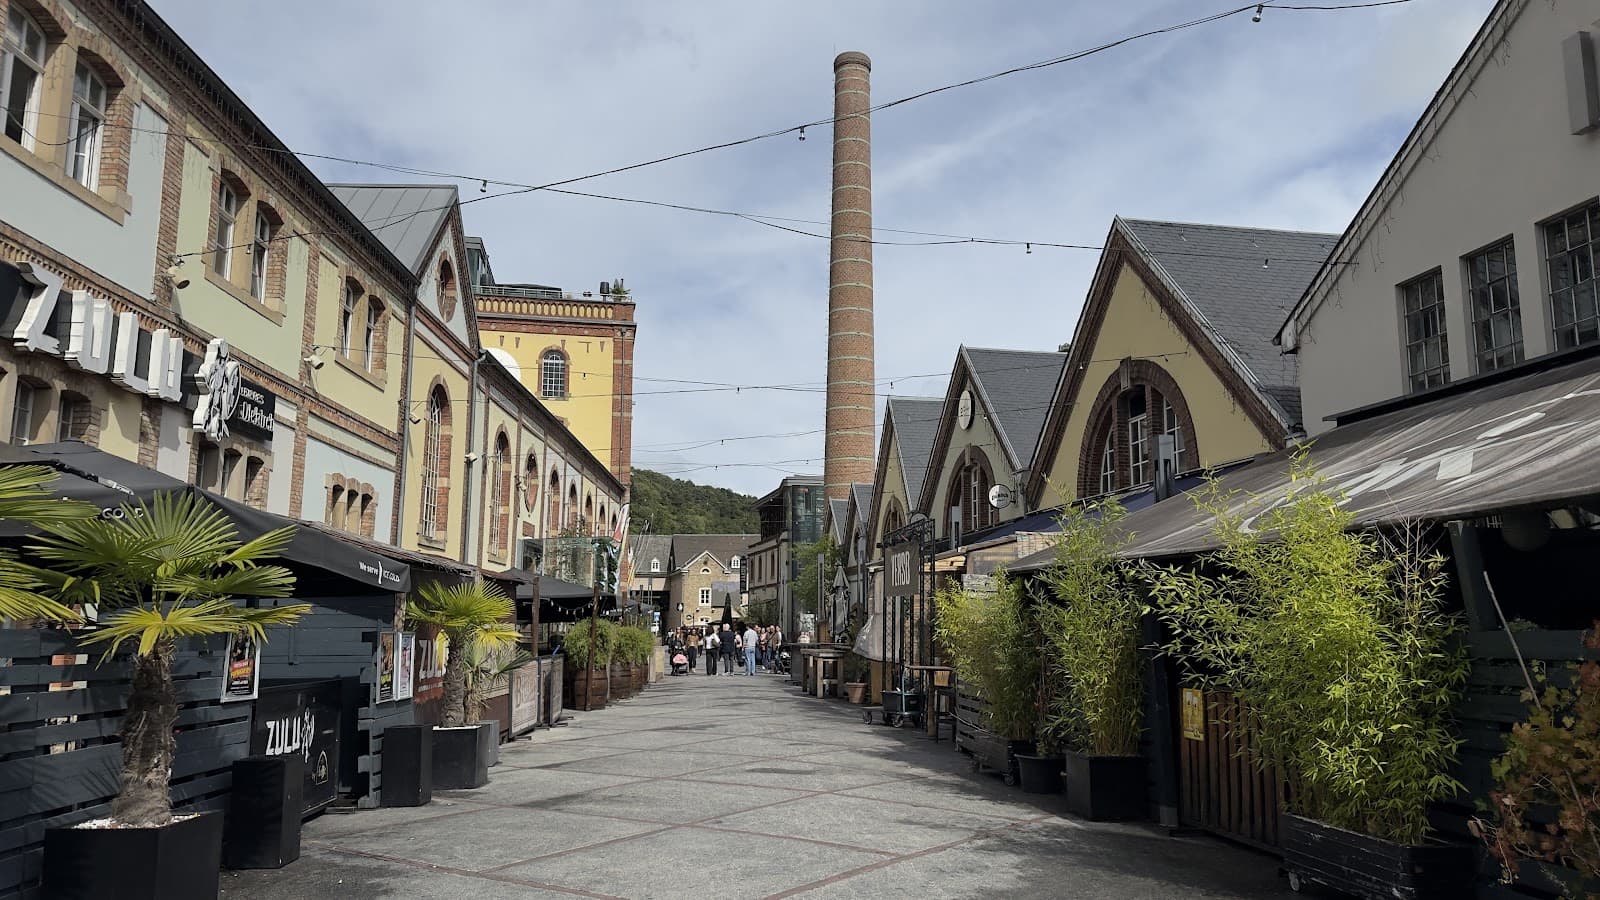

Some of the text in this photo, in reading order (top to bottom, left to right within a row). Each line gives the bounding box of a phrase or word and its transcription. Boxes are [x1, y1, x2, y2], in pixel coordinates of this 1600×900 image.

[13, 261, 183, 402] ZULU
[102, 507, 144, 519] COD
[265, 716, 301, 755] ZULU
